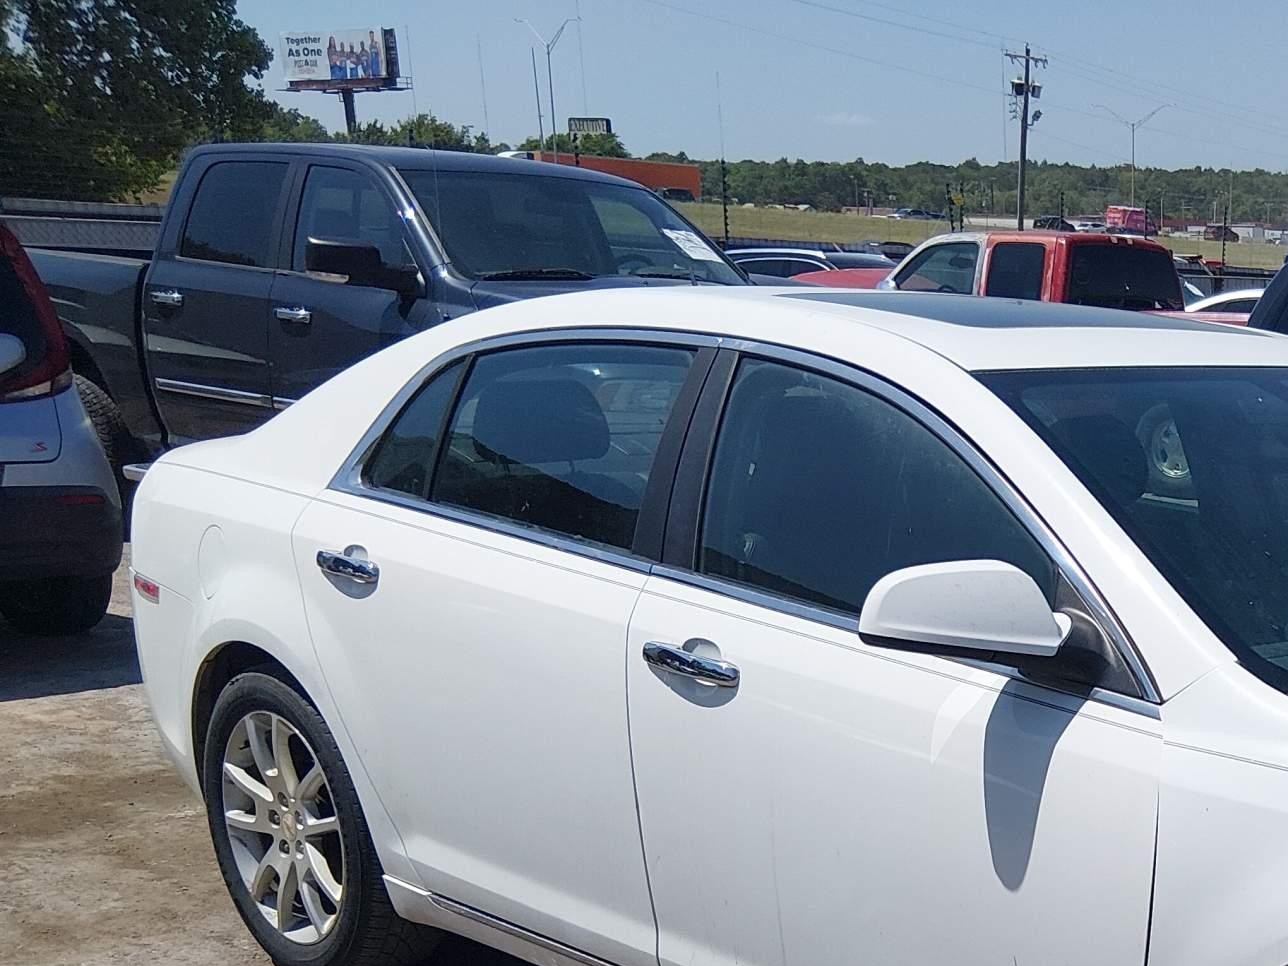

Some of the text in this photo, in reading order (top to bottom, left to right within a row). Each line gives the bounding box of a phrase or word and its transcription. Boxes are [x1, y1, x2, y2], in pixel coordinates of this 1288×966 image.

[285, 36, 321, 46] Together
[288, 47, 323, 57] As One
